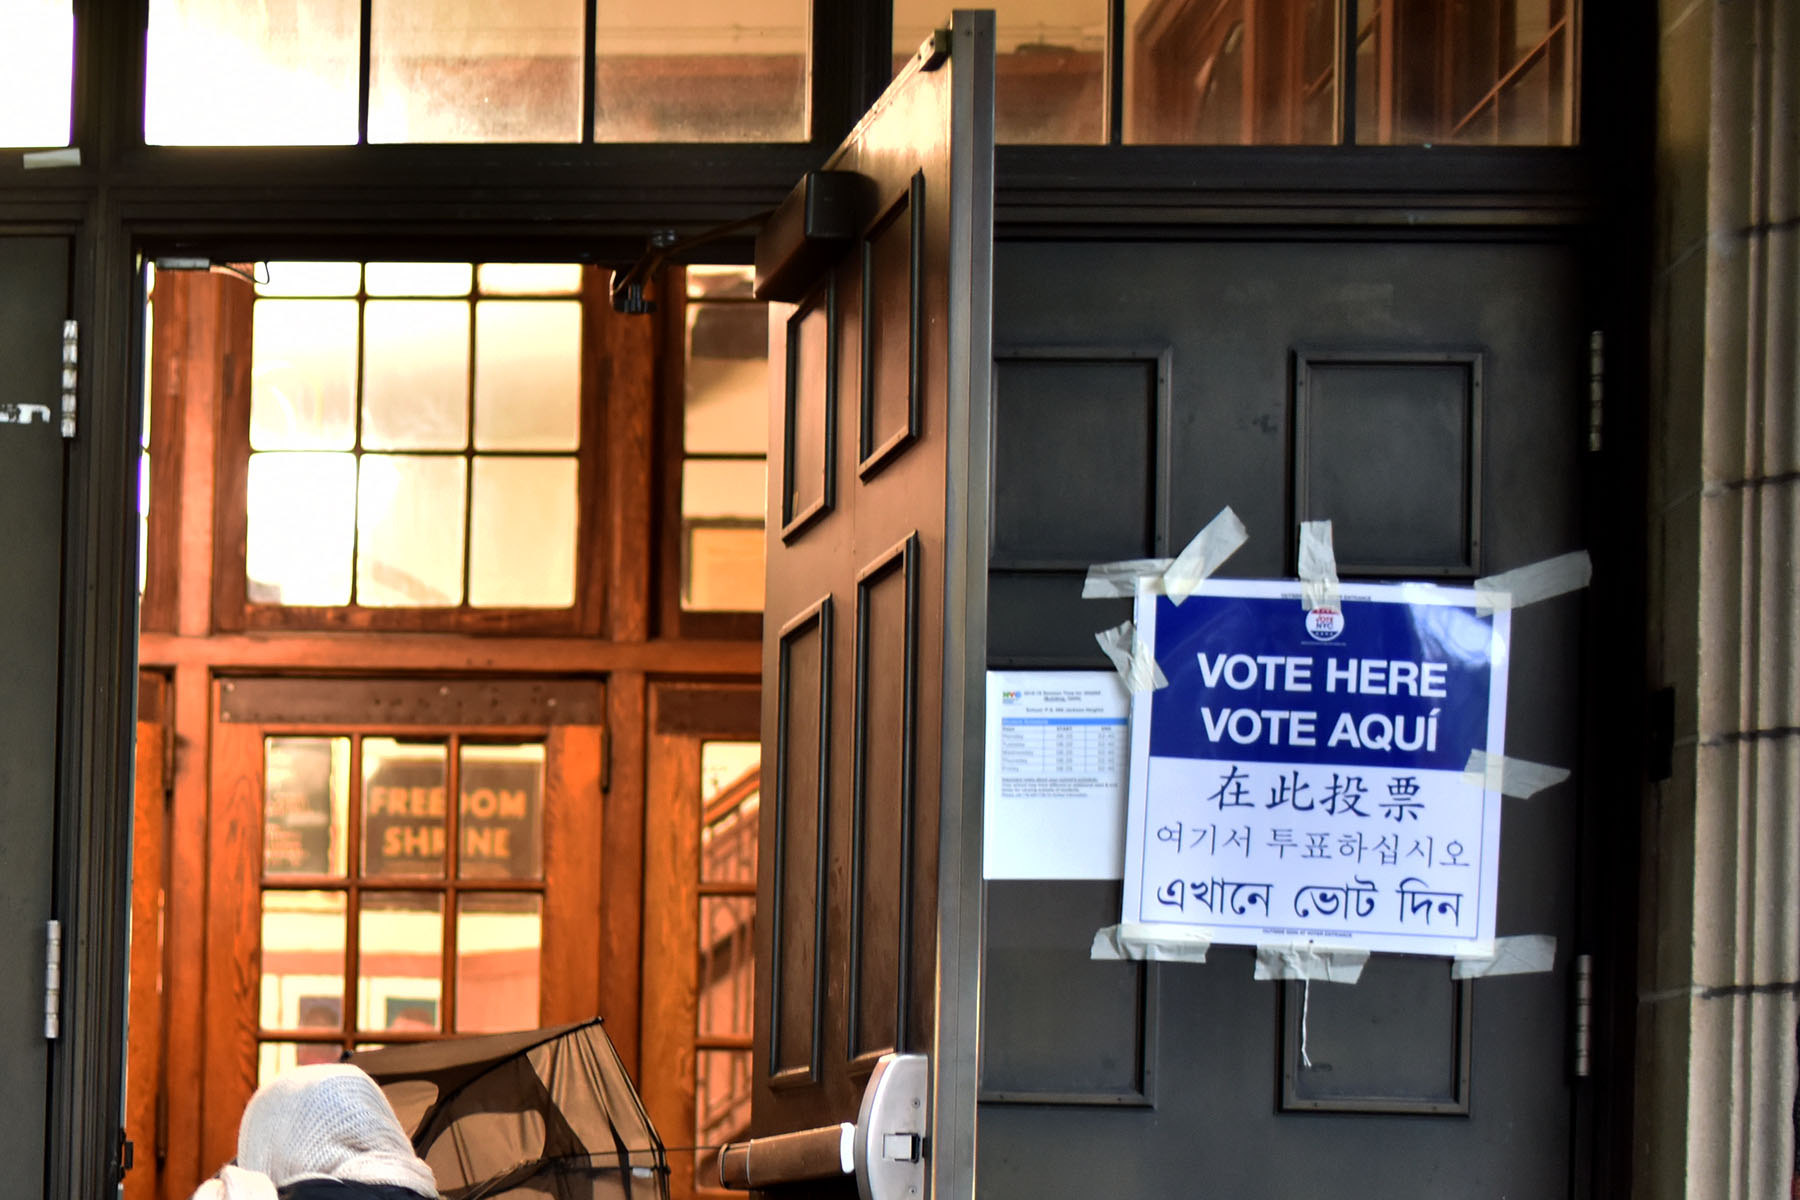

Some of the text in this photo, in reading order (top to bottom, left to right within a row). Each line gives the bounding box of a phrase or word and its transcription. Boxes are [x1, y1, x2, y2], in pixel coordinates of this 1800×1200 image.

[1197, 652, 1448, 698] VOTE HERE
[1201, 706, 1441, 752] VOTE AQUÍ
[1207, 764, 1425, 823] 在此投票
[1157, 821, 1470, 868] 여기서 투표하십시오
[1157, 874, 1464, 927] এখানে ভোট দিন
